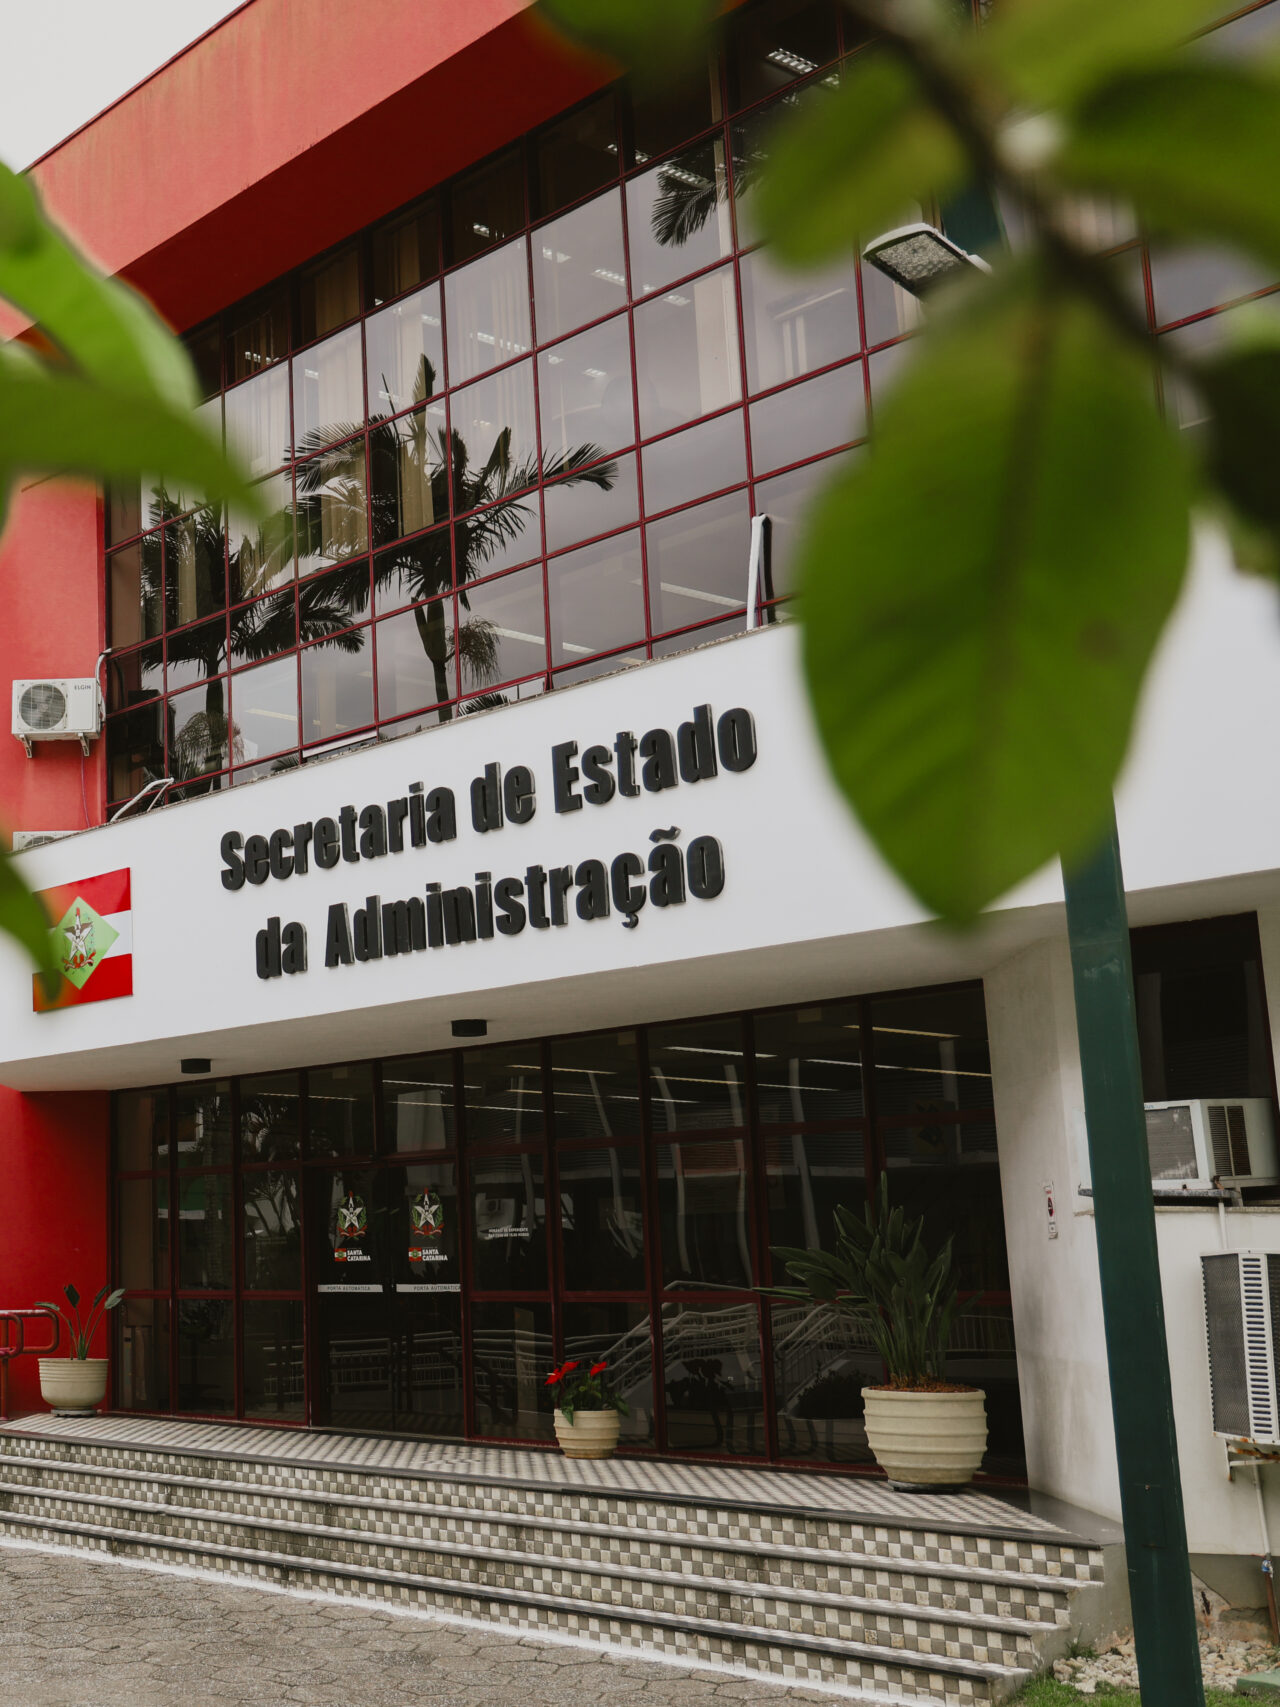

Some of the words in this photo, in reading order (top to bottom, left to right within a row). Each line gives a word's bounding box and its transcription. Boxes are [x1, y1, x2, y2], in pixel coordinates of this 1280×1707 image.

[221, 781, 457, 892] Secretaria
[471, 762, 537, 833] de
[551, 704, 758, 814] Estado
[256, 917, 308, 979] da
[325, 826, 726, 968] Administração
